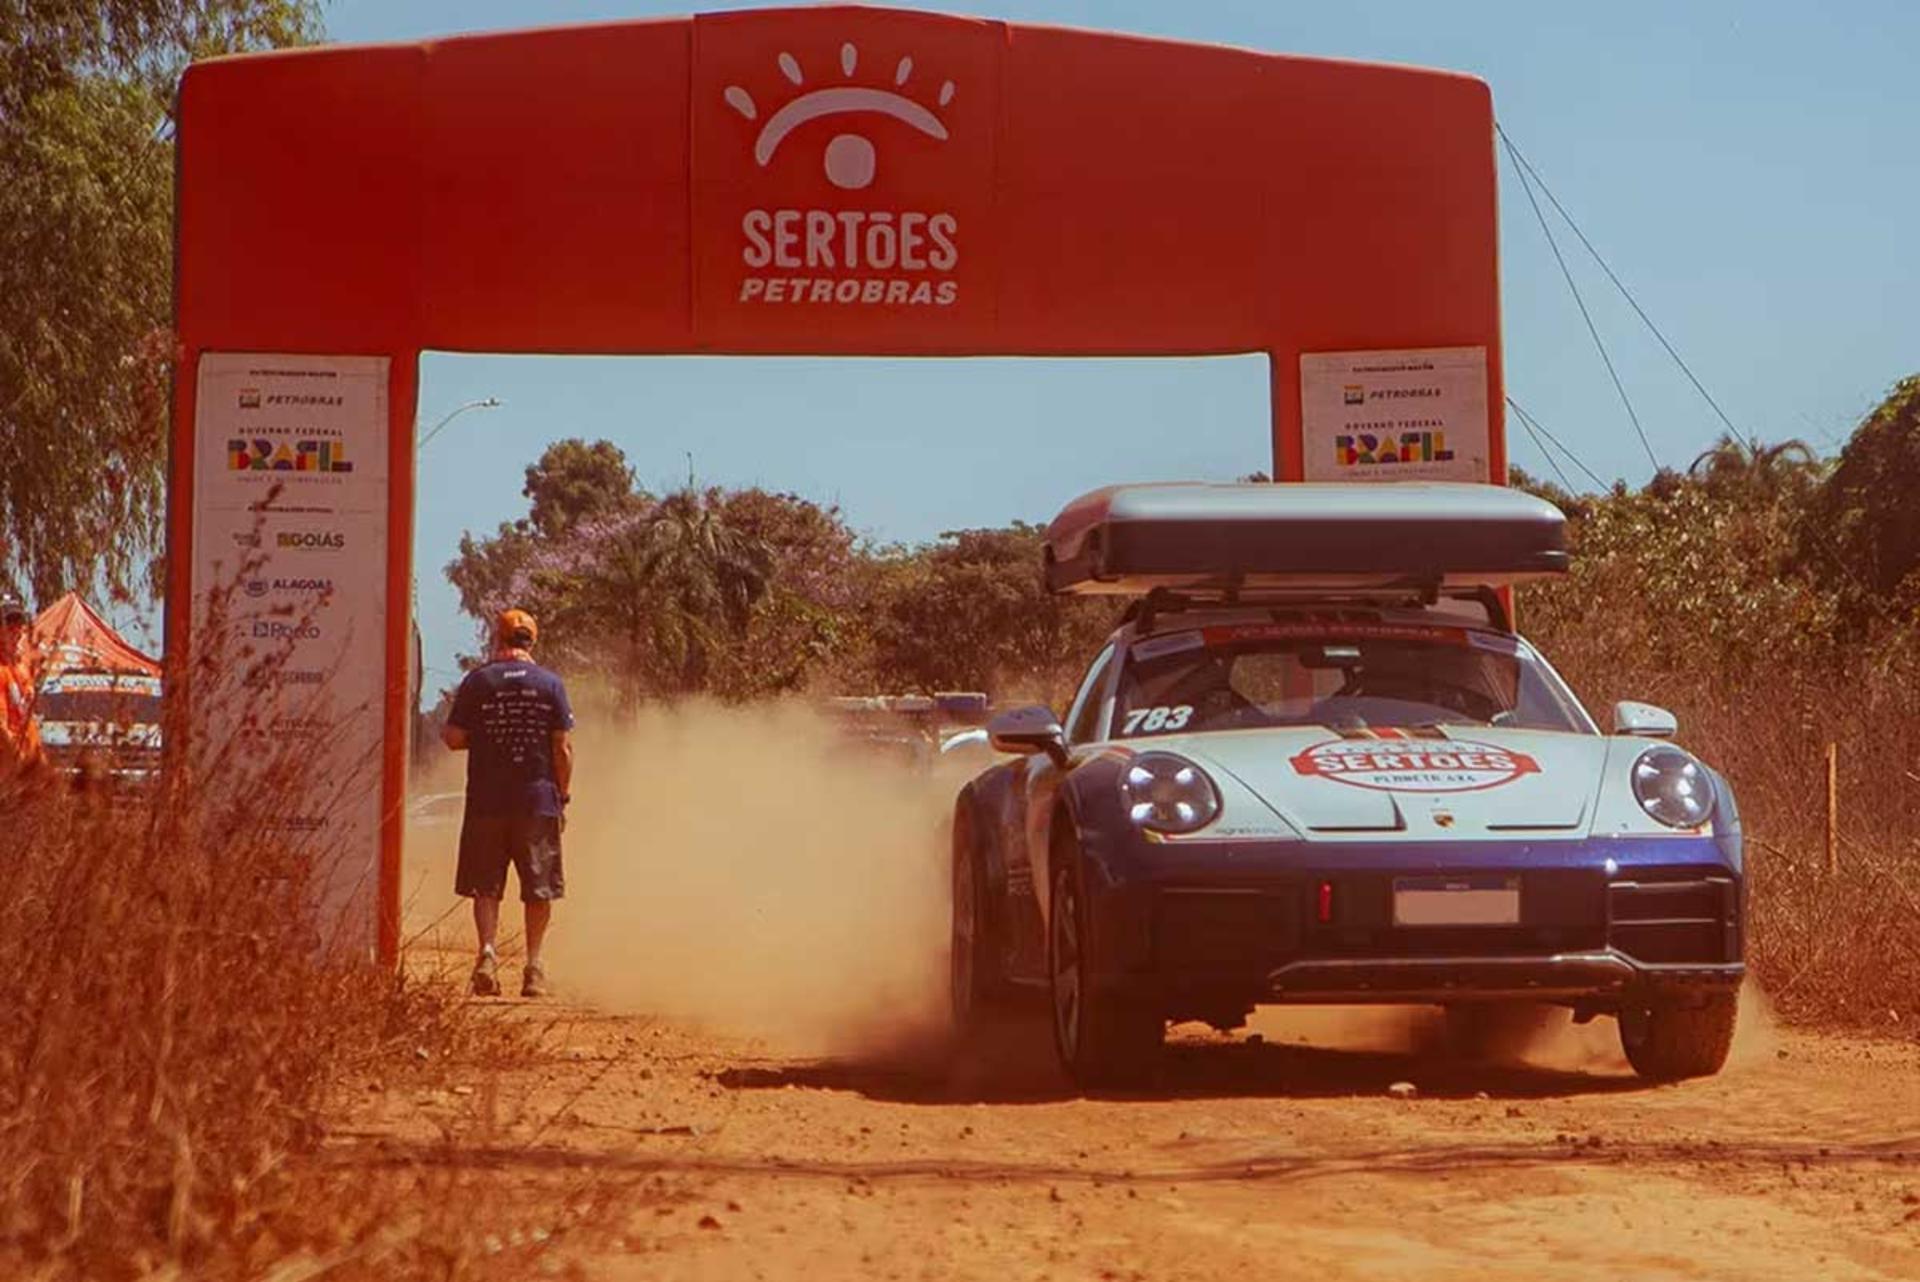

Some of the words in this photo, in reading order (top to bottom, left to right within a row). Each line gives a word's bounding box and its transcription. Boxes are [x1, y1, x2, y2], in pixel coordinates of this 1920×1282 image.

[739, 278, 958, 304] PETROBRAS
[266, 395, 343, 406] PETROBRAS
[1369, 388, 1442, 399] PETROBRAS
[228, 438, 353, 473] BRASIL
[1336, 431, 1454, 465] BRASIL
[1122, 705, 1194, 735] 783
